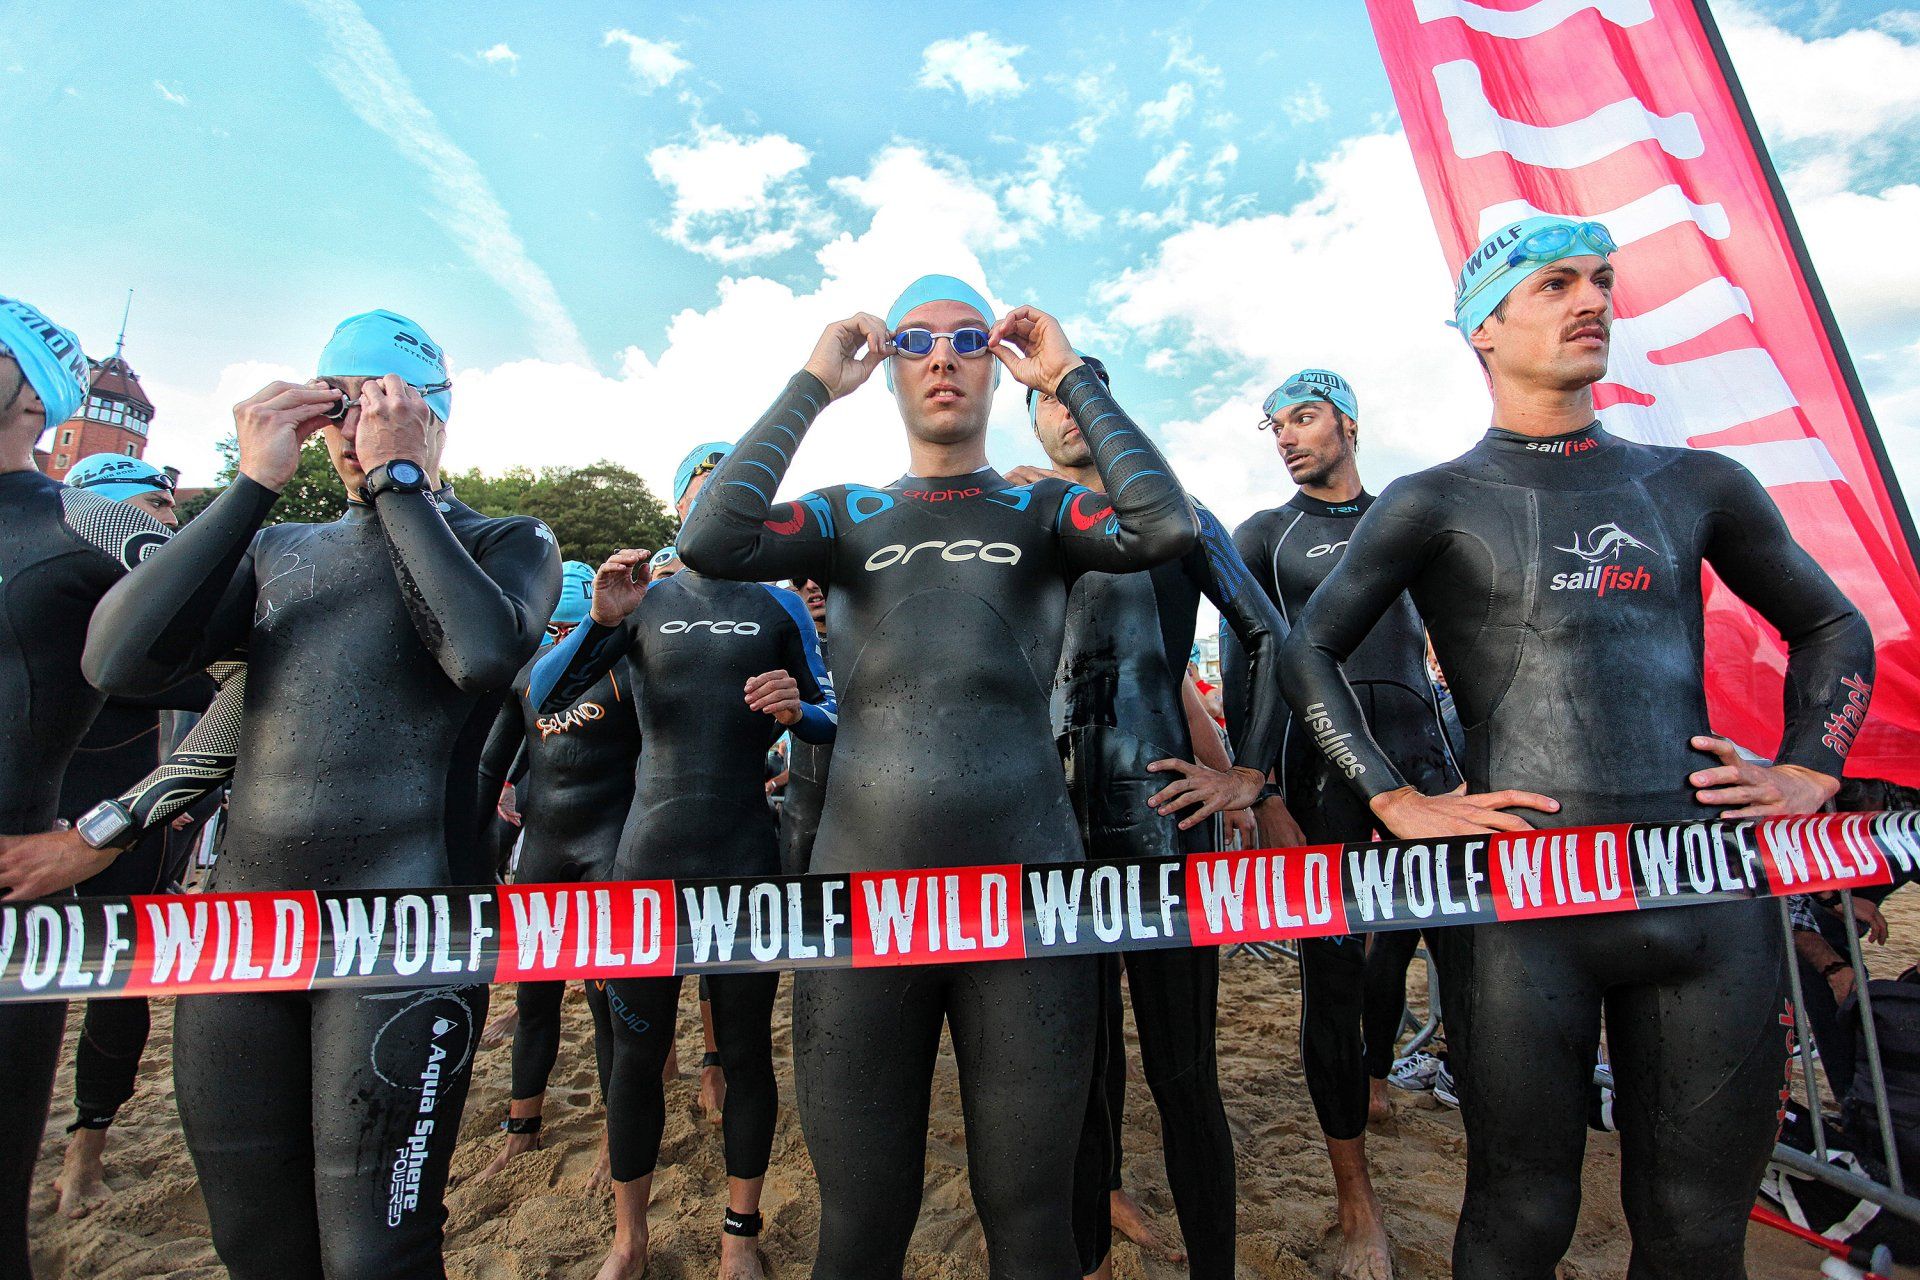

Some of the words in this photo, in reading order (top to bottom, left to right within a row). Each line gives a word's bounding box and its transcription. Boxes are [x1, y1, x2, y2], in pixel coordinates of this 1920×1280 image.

[1466, 224, 1523, 276] WOLF
[1303, 373, 1338, 388] WILD
[1525, 437, 1599, 457] sailfish
[71, 461, 135, 488] OLAR
[902, 487, 984, 503] alpha
[864, 539, 1022, 572] orca
[1306, 541, 1349, 558] or
[1550, 565, 1652, 597] sailfish
[659, 620, 761, 636] orca
[1821, 672, 1872, 759] attack
[1304, 702, 1366, 780] sailfish
[146, 899, 304, 984] WILD
[325, 894, 493, 977] WOLF
[508, 888, 662, 971] WILD
[682, 881, 845, 963] WOLF
[862, 873, 1009, 955] WILD
[1028, 863, 1180, 945] WOLF
[1196, 853, 1332, 934] WILD
[1348, 841, 1484, 921] WOLF
[1498, 832, 1621, 909] WILD
[1634, 821, 1756, 897] WOLF
[1763, 815, 1878, 885] WILD
[419, 1043, 447, 1113] Aqua
[403, 1119, 434, 1211] Sphere
[388, 1147, 410, 1227] POWERED
